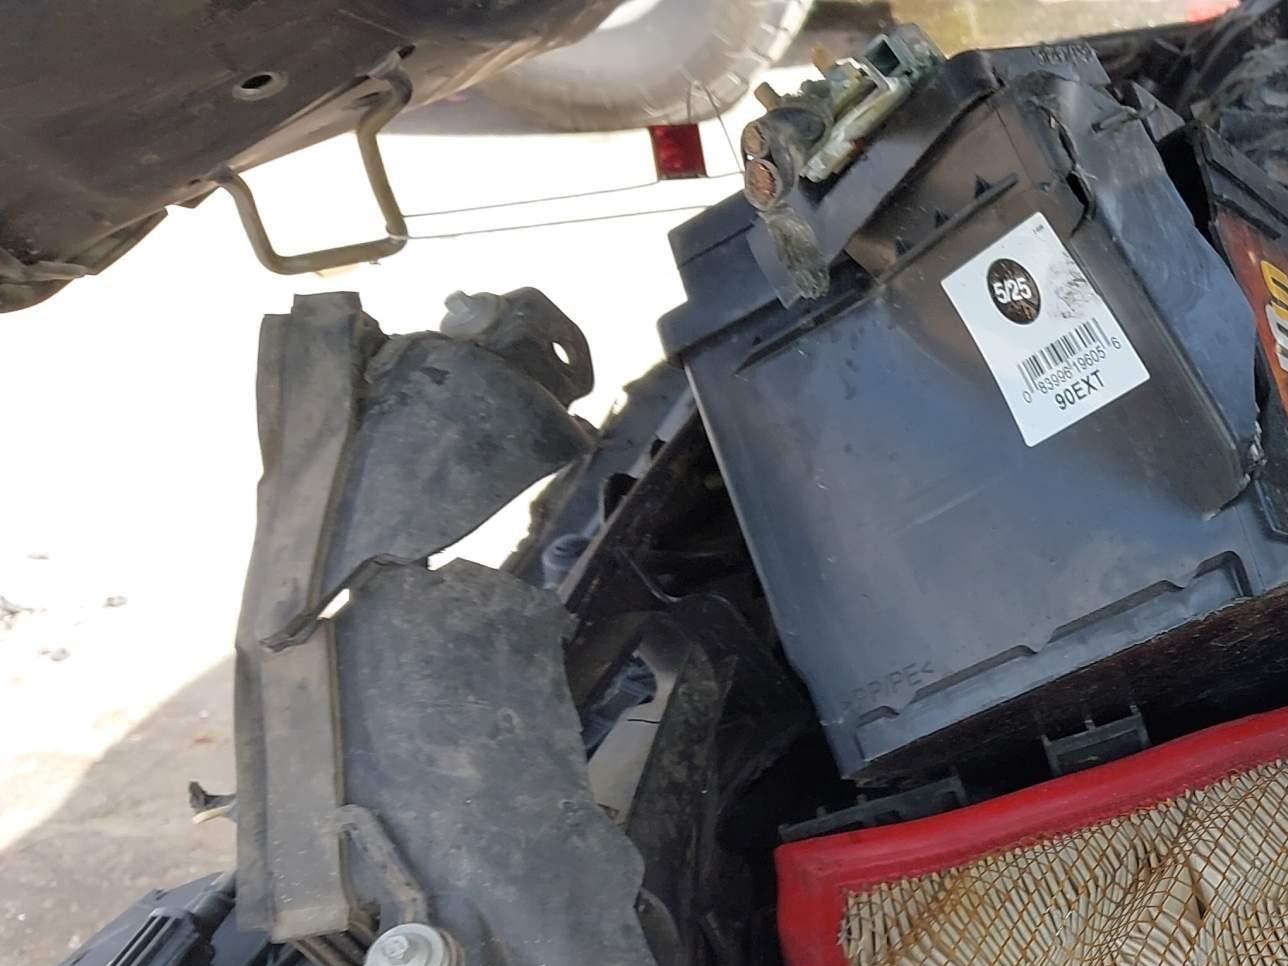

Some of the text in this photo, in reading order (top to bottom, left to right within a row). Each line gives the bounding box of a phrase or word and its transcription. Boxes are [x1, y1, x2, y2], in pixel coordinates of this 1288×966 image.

[992, 277, 1032, 304] 5/25
[1023, 390, 1032, 403] 0
[1111, 336, 1121, 350] 6
[1054, 369, 1105, 411] 90EXT
